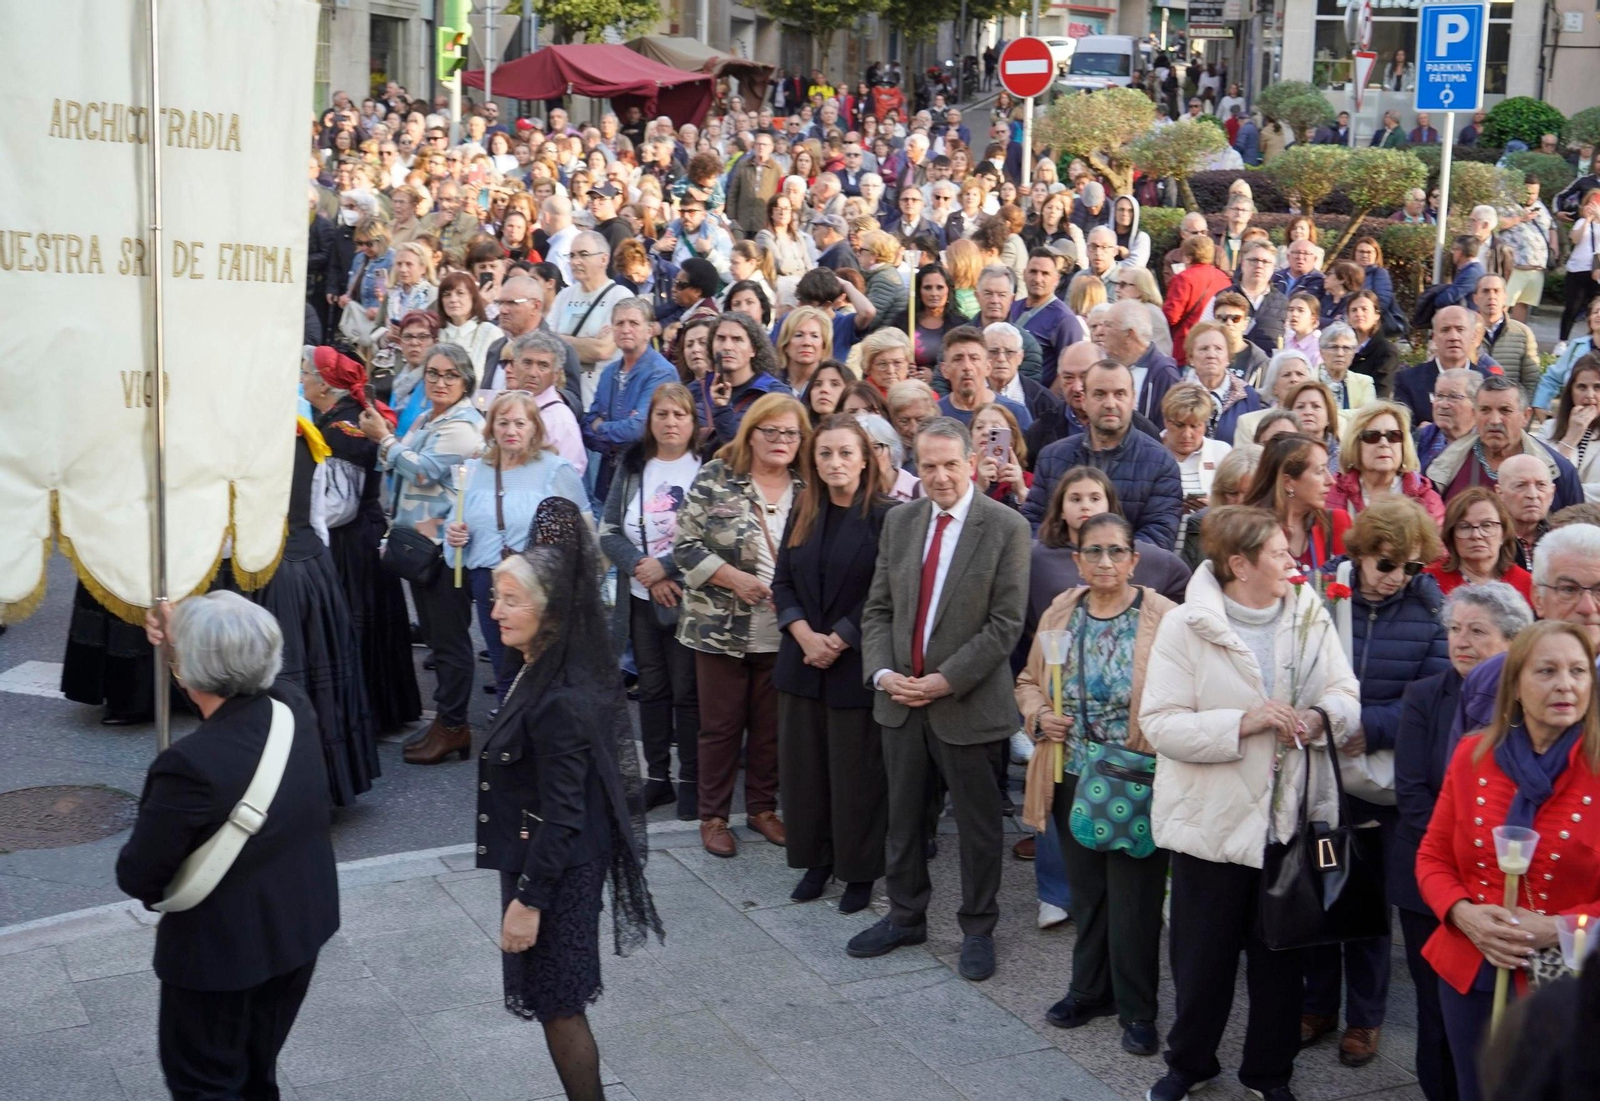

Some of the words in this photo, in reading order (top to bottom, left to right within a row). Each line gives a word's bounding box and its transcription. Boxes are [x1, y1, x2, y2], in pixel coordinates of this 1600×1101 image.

[1436, 14, 1470, 57] P
[1426, 63, 1472, 72] PARKING
[1429, 72, 1467, 82] FÁTIMA
[117, 237, 153, 277] SR
[172, 240, 205, 280] DE
[217, 243, 294, 284] FATIMA
